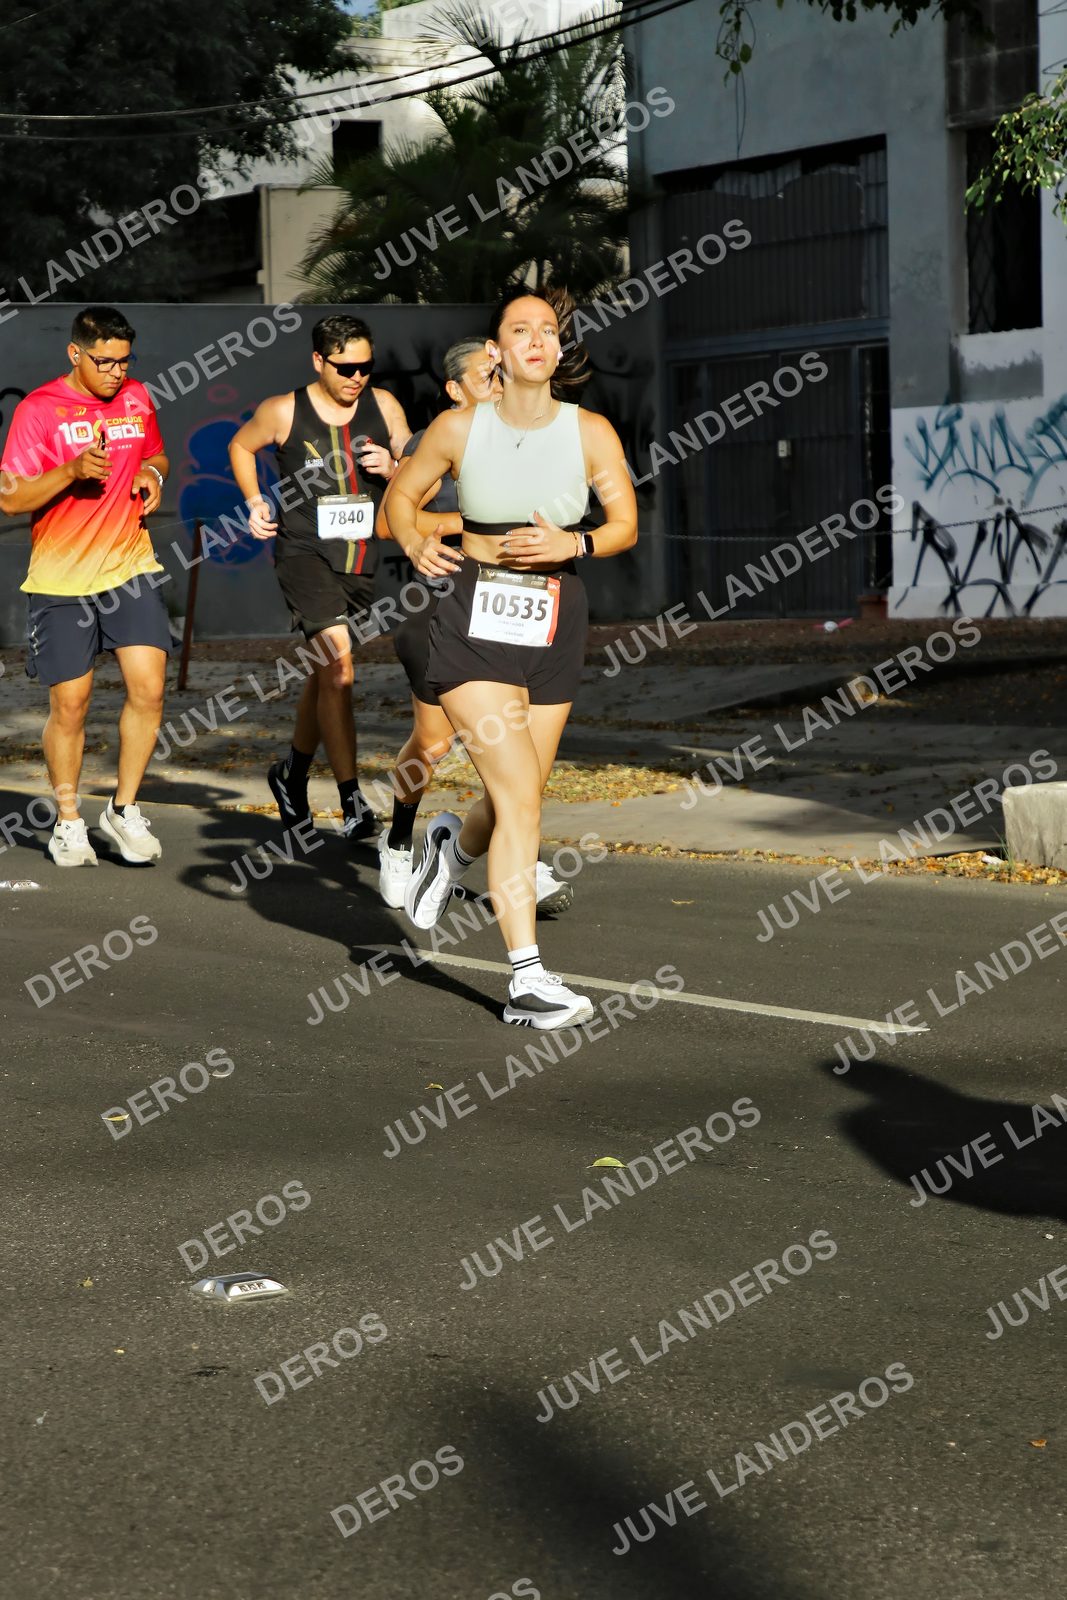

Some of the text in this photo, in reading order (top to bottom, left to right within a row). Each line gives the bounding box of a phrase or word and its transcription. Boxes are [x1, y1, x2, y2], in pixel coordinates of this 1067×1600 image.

[106, 416, 143, 426] COMUDE
[107, 423, 145, 440] GDL
[329, 509, 364, 526] 7840
[479, 591, 548, 621] 10535
